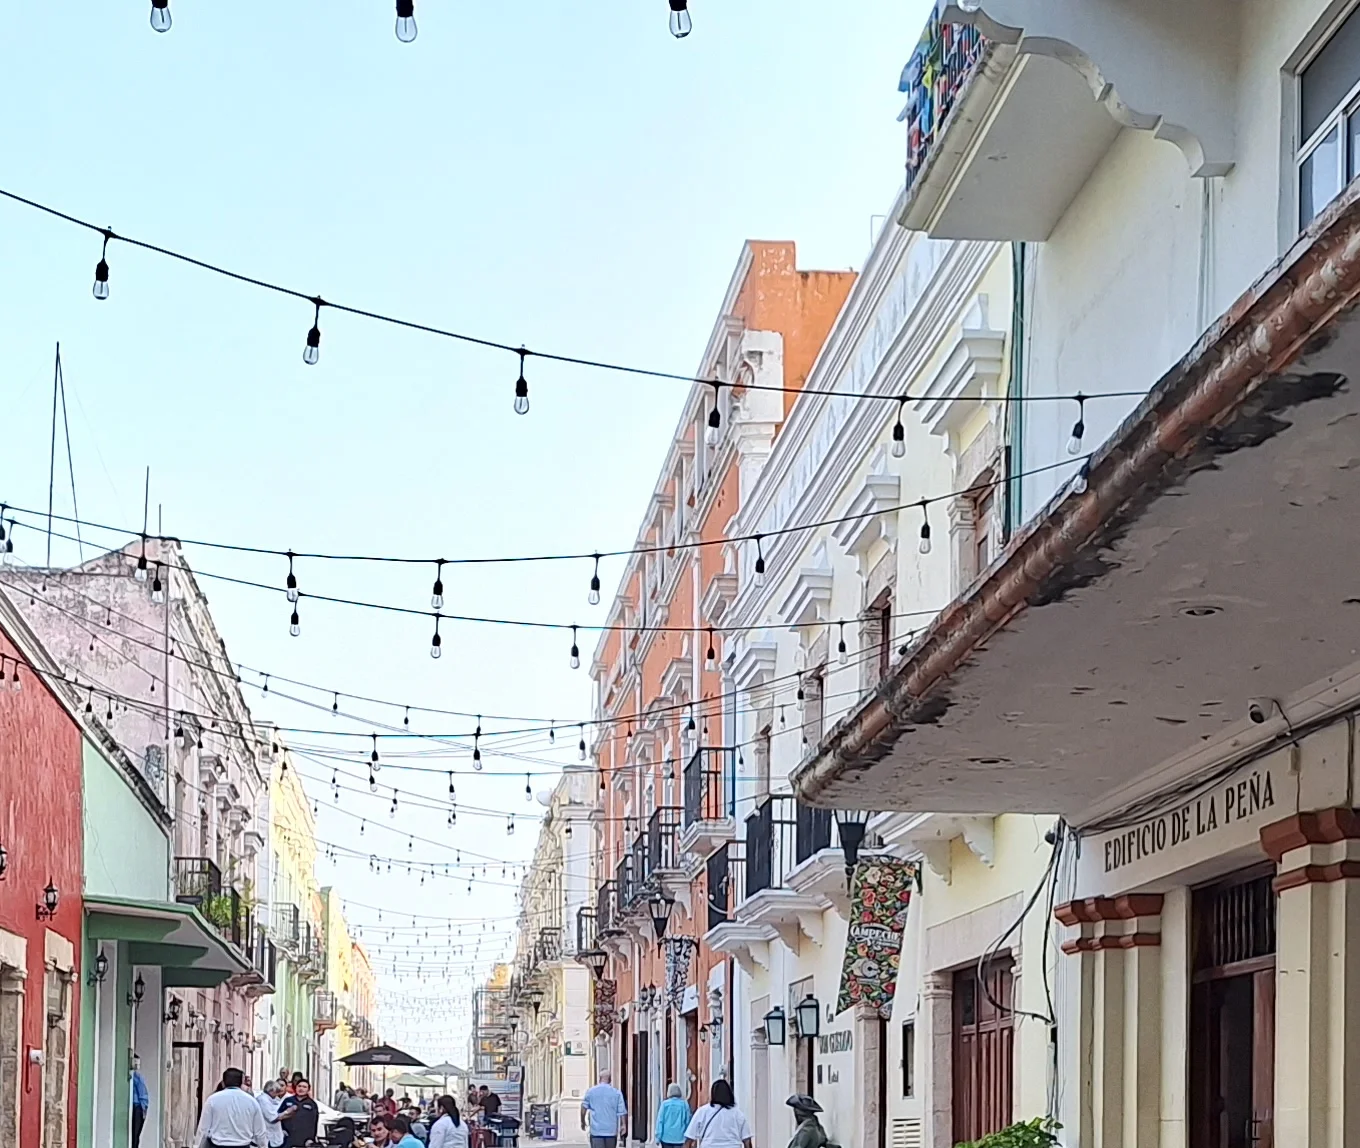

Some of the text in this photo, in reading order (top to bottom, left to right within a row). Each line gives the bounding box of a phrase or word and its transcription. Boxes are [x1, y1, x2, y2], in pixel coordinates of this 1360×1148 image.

[1103, 770, 1275, 874] EDIFICIO DE LA PEÑA
